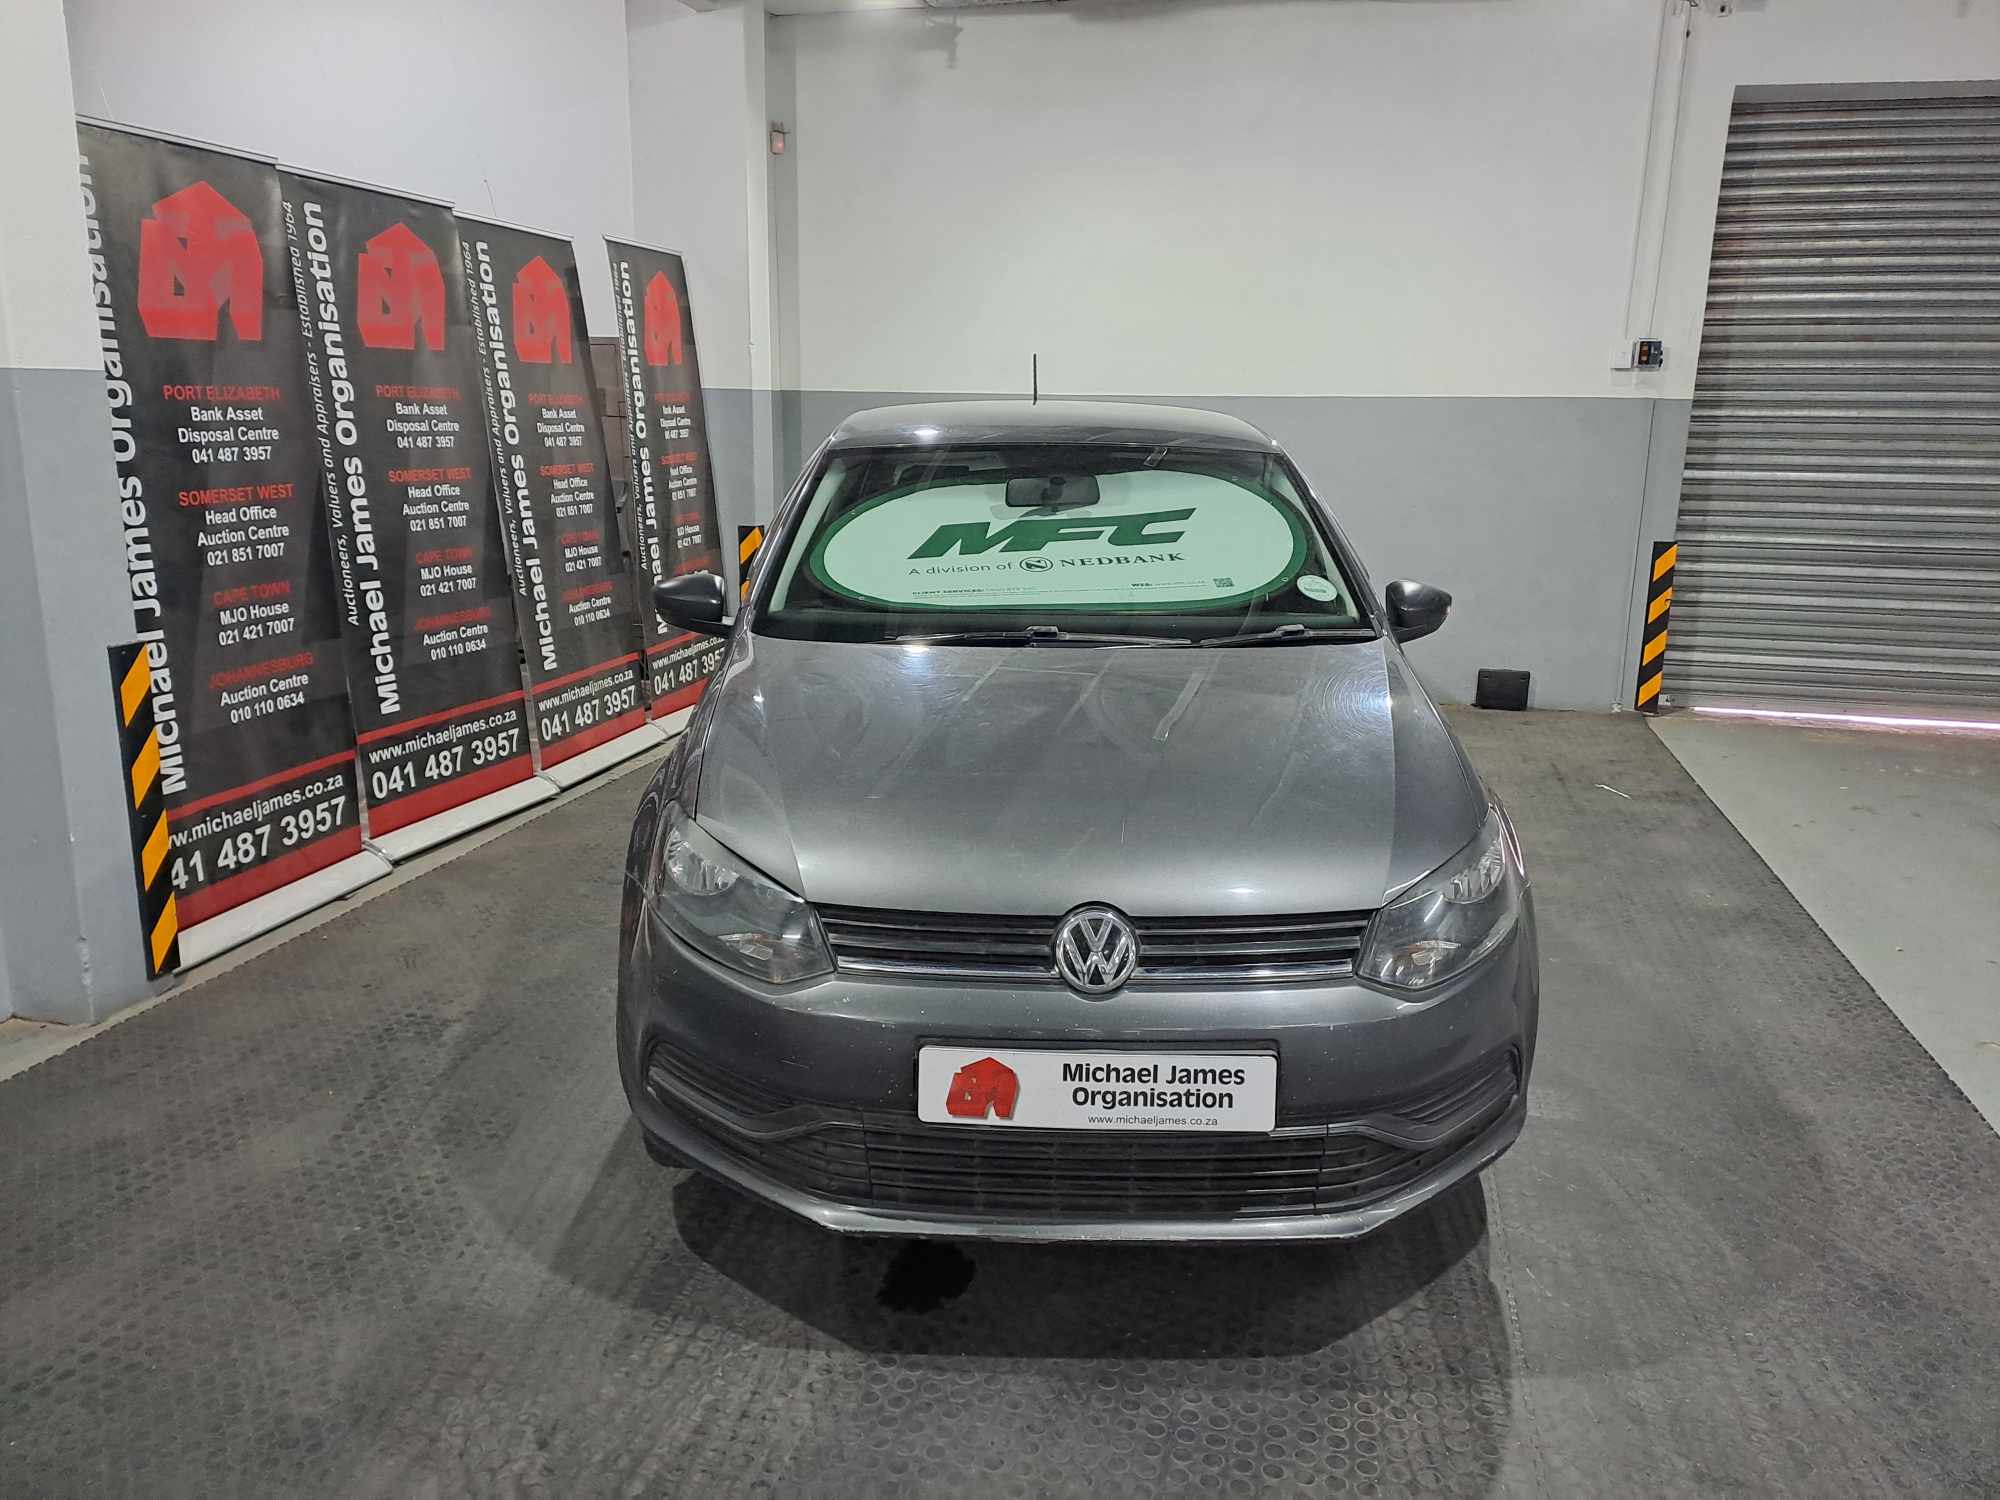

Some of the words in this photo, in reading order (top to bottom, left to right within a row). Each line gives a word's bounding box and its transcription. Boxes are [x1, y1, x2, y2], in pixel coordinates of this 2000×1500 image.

[289, 246, 312, 338] Established
[303, 201, 358, 446] Organisation
[475, 240, 520, 445] Organisation
[162, 384, 201, 400] PORT
[307, 352, 329, 435] Appraisers
[191, 406, 223, 421] Bank
[226, 406, 264, 421] Asset
[395, 402, 421, 415] Bank
[422, 403, 448, 415] Asset
[178, 427, 235, 445] Disposal
[237, 426, 280, 441] Centre
[386, 419, 429, 434] Disposal
[431, 420, 460, 432] Centre
[192, 448, 214, 463] 041
[217, 447, 239, 462] 487
[244, 445, 272, 461] 3957
[317, 438, 333, 468] and
[397, 437, 414, 449] 041
[416, 436, 432, 448] 487
[436, 436, 455, 448] 3957
[493, 438, 504, 464] and
[388, 468, 444, 482] SOMERSET
[639, 446, 658, 530] James
[178, 486, 253, 506] SOMERSET
[257, 483, 295, 499] WEST
[325, 472, 343, 528] Valuers
[407, 486, 432, 498] Head
[433, 484, 461, 496] Office
[500, 468, 514, 514] Valuers
[510, 454, 538, 550] James
[205, 508, 236, 525] Head
[239, 505, 277, 521] Office
[343, 456, 379, 571] James
[402, 502, 439, 516] Auction
[441, 500, 470, 513] Centre
[197, 528, 245, 547] Auction
[248, 524, 290, 540] Centre
[410, 519, 426, 532] 021
[428, 517, 445, 529] 851
[447, 515, 467, 528] 7007
[906, 507, 1197, 560] MFC
[118, 476, 161, 617] James
[207, 550, 229, 566] 021
[232, 547, 252, 562] 851
[257, 542, 285, 559] 7007
[420, 566, 442, 581] MJO
[444, 563, 473, 576] House
[908, 568, 921, 576] A
[926, 562, 991, 576] division
[995, 560, 1013, 572] of
[1060, 552, 1186, 568] NEDBANK
[420, 583, 437, 597] 021
[438, 580, 455, 593] 421
[457, 577, 477, 590] 7007
[648, 536, 668, 635] Mael
[220, 607, 247, 626] MJO
[250, 601, 289, 620] House
[525, 557, 558, 671] Michael
[218, 629, 241, 647] 021
[243, 623, 264, 641] 421
[266, 617, 295, 637] 7007
[359, 579, 401, 715] Michael
[422, 628, 458, 646] Auction
[459, 623, 489, 639] Centre
[430, 647, 447, 661] 010
[448, 643, 464, 657] 110
[652, 637, 725, 670] www.michaeljames.co.
[654, 668, 675, 695] 041
[679, 658, 698, 683] 487
[701, 646, 726, 674] 395
[220, 683, 268, 707] Auction
[269, 673, 310, 693] Centre
[538, 668, 634, 712] www.michaeljames.co.za
[230, 708, 251, 724] 010
[254, 700, 275, 717] 110
[277, 691, 305, 711] 0634
[541, 710, 570, 741] 041
[574, 699, 600, 728] 487
[603, 685, 637, 717] 3957
[368, 708, 517, 764] www.michaeljames.co.za
[372, 760, 417, 799] 041
[424, 743, 465, 780] 487
[471, 727, 520, 768] 3957
[169, 773, 344, 850] w.michaeljames.co.za
[170, 850, 205, 890] 41
[217, 824, 272, 870] 487
[279, 795, 346, 846] 3957
[1061, 1062, 1159, 1084] Michael
[1166, 1064, 1246, 1086] James
[1071, 1085, 1235, 1109] Organisation
[1087, 1115, 1219, 1127] www.michaeljames.co.za
